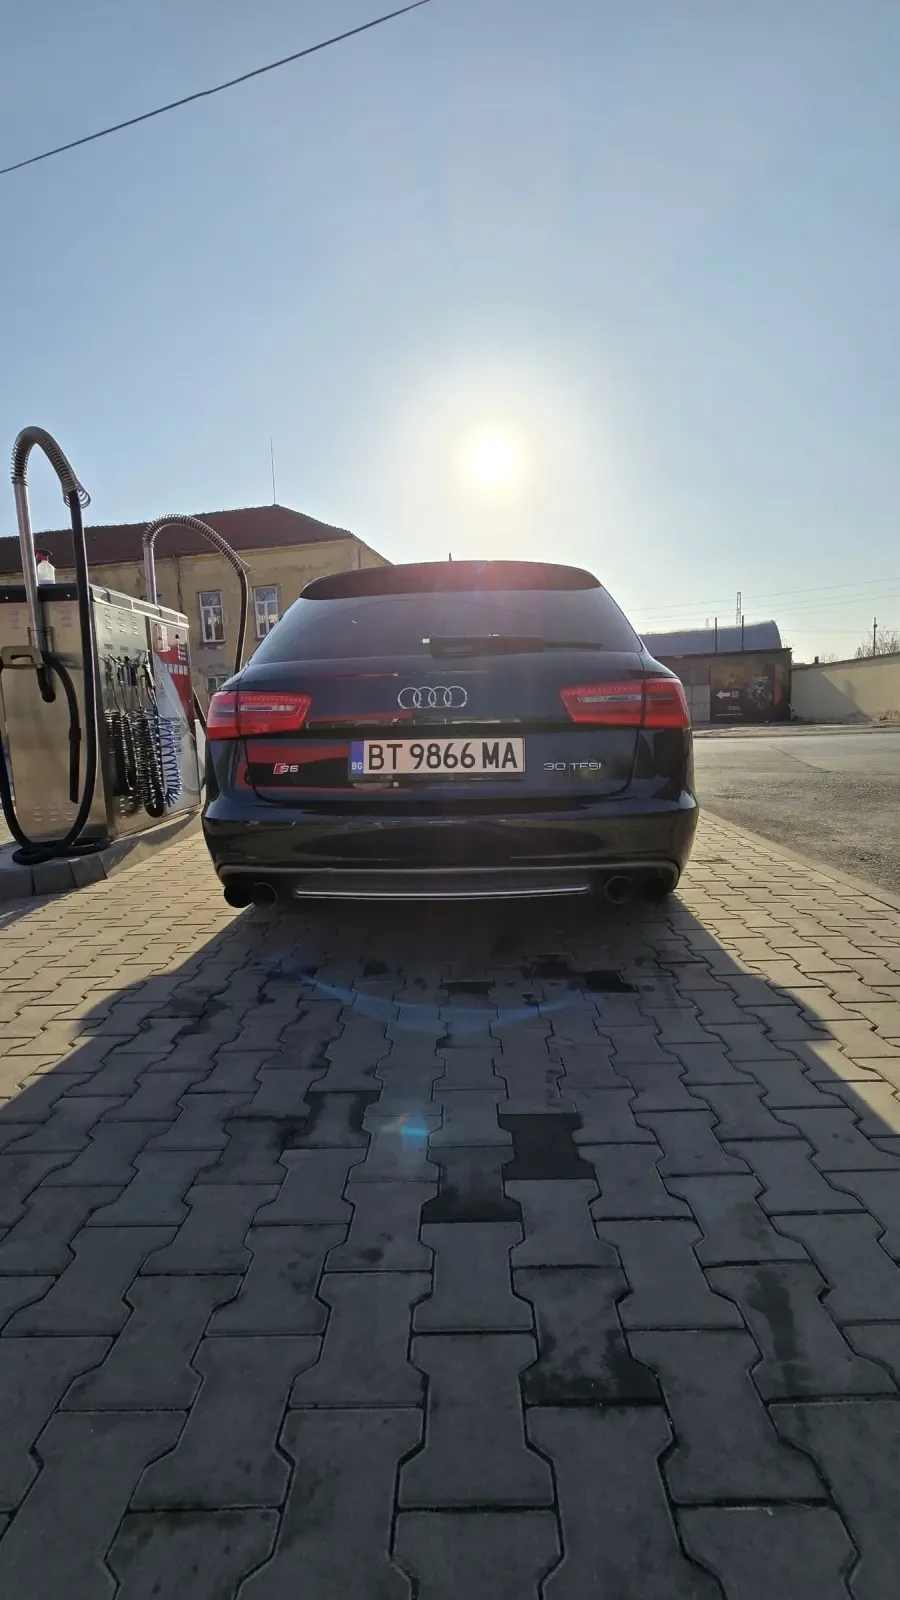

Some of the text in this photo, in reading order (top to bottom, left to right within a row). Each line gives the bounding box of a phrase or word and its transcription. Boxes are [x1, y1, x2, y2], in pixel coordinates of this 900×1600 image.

[368, 741, 518, 770] BT 9866 MA
[277, 763, 299, 774] S6
[351, 761, 363, 770] BG
[569, 762, 602, 771] TFSI
